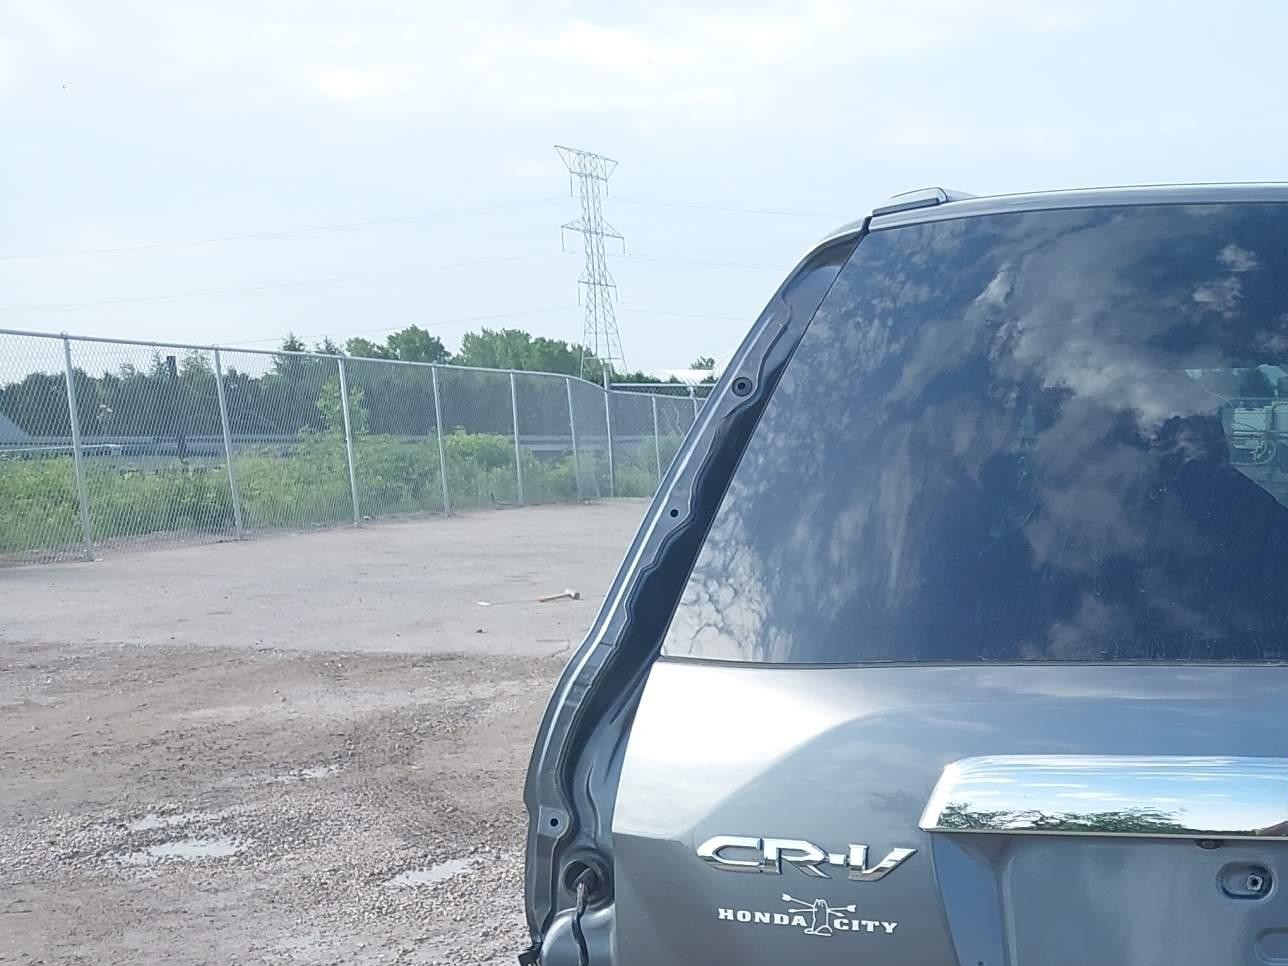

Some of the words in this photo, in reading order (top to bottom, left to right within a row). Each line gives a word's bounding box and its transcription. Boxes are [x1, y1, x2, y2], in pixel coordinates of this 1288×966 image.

[696, 835, 918, 882] CR-V
[718, 908, 808, 928] HONDA
[833, 918, 898, 934] CITY
